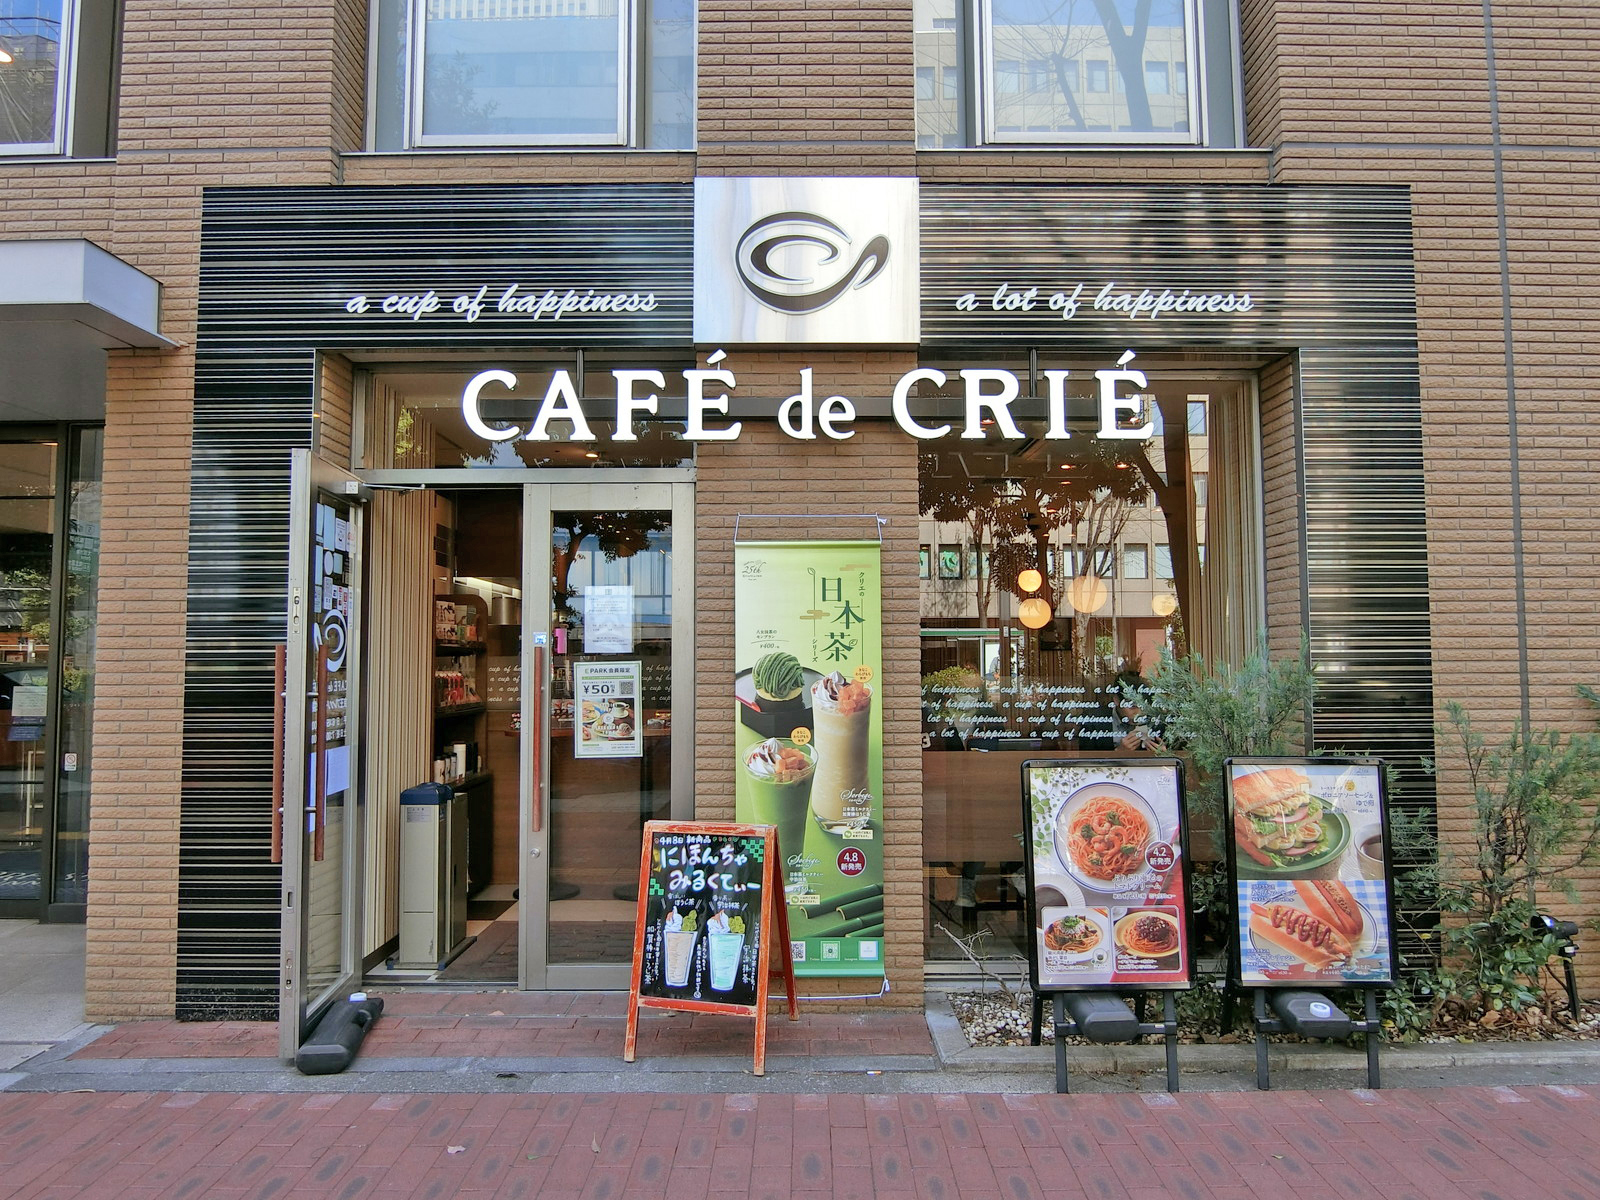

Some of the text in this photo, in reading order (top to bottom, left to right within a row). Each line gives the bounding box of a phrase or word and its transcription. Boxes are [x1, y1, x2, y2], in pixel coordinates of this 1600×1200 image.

[346, 283, 659, 322] a cup of happiness
[955, 282, 1255, 320] a lot of happiness
[461, 349, 1155, 441] CAFÉ de CRIÉ
[820, 577, 866, 662] 日本茶
[583, 684, 609, 695] ¥50
[931, 684, 980, 695] happiness
[1000, 686, 1018, 695] cup
[1037, 684, 1085, 695] happiness
[1105, 684, 1120, 694] lot
[931, 698, 942, 710] of
[945, 698, 994, 709] happiness
[1014, 700, 1032, 709] cup
[1036, 698, 1047, 711] of
[1051, 698, 1100, 709] happiness
[1119, 699, 1133, 708] lot
[927, 713, 941, 723] lot
[945, 714, 955, 725] of
[959, 713, 1008, 723] happiness
[1028, 715, 1046, 724] cup
[1050, 713, 1061, 725] of
[1065, 713, 1113, 724] happiness
[1133, 713, 1148, 723] lot
[941, 728, 955, 737] lot
[958, 728, 969, 740] of
[972, 728, 1022, 739] happiness
[1041, 730, 1060, 739] cup
[1063, 728, 1075, 740] of
[1078, 728, 1128, 739] happiness
[1147, 728, 1161, 737] lot
[660, 835, 684, 845] 4月8日
[661, 843, 748, 869] にほんちゃ
[843, 852, 859, 862] 4.8
[1153, 847, 1167, 856] 4.2
[840, 863, 862, 871] 新発売
[669, 869, 761, 892] みるくてぃー
[674, 898, 695, 906] ほうじ茶
